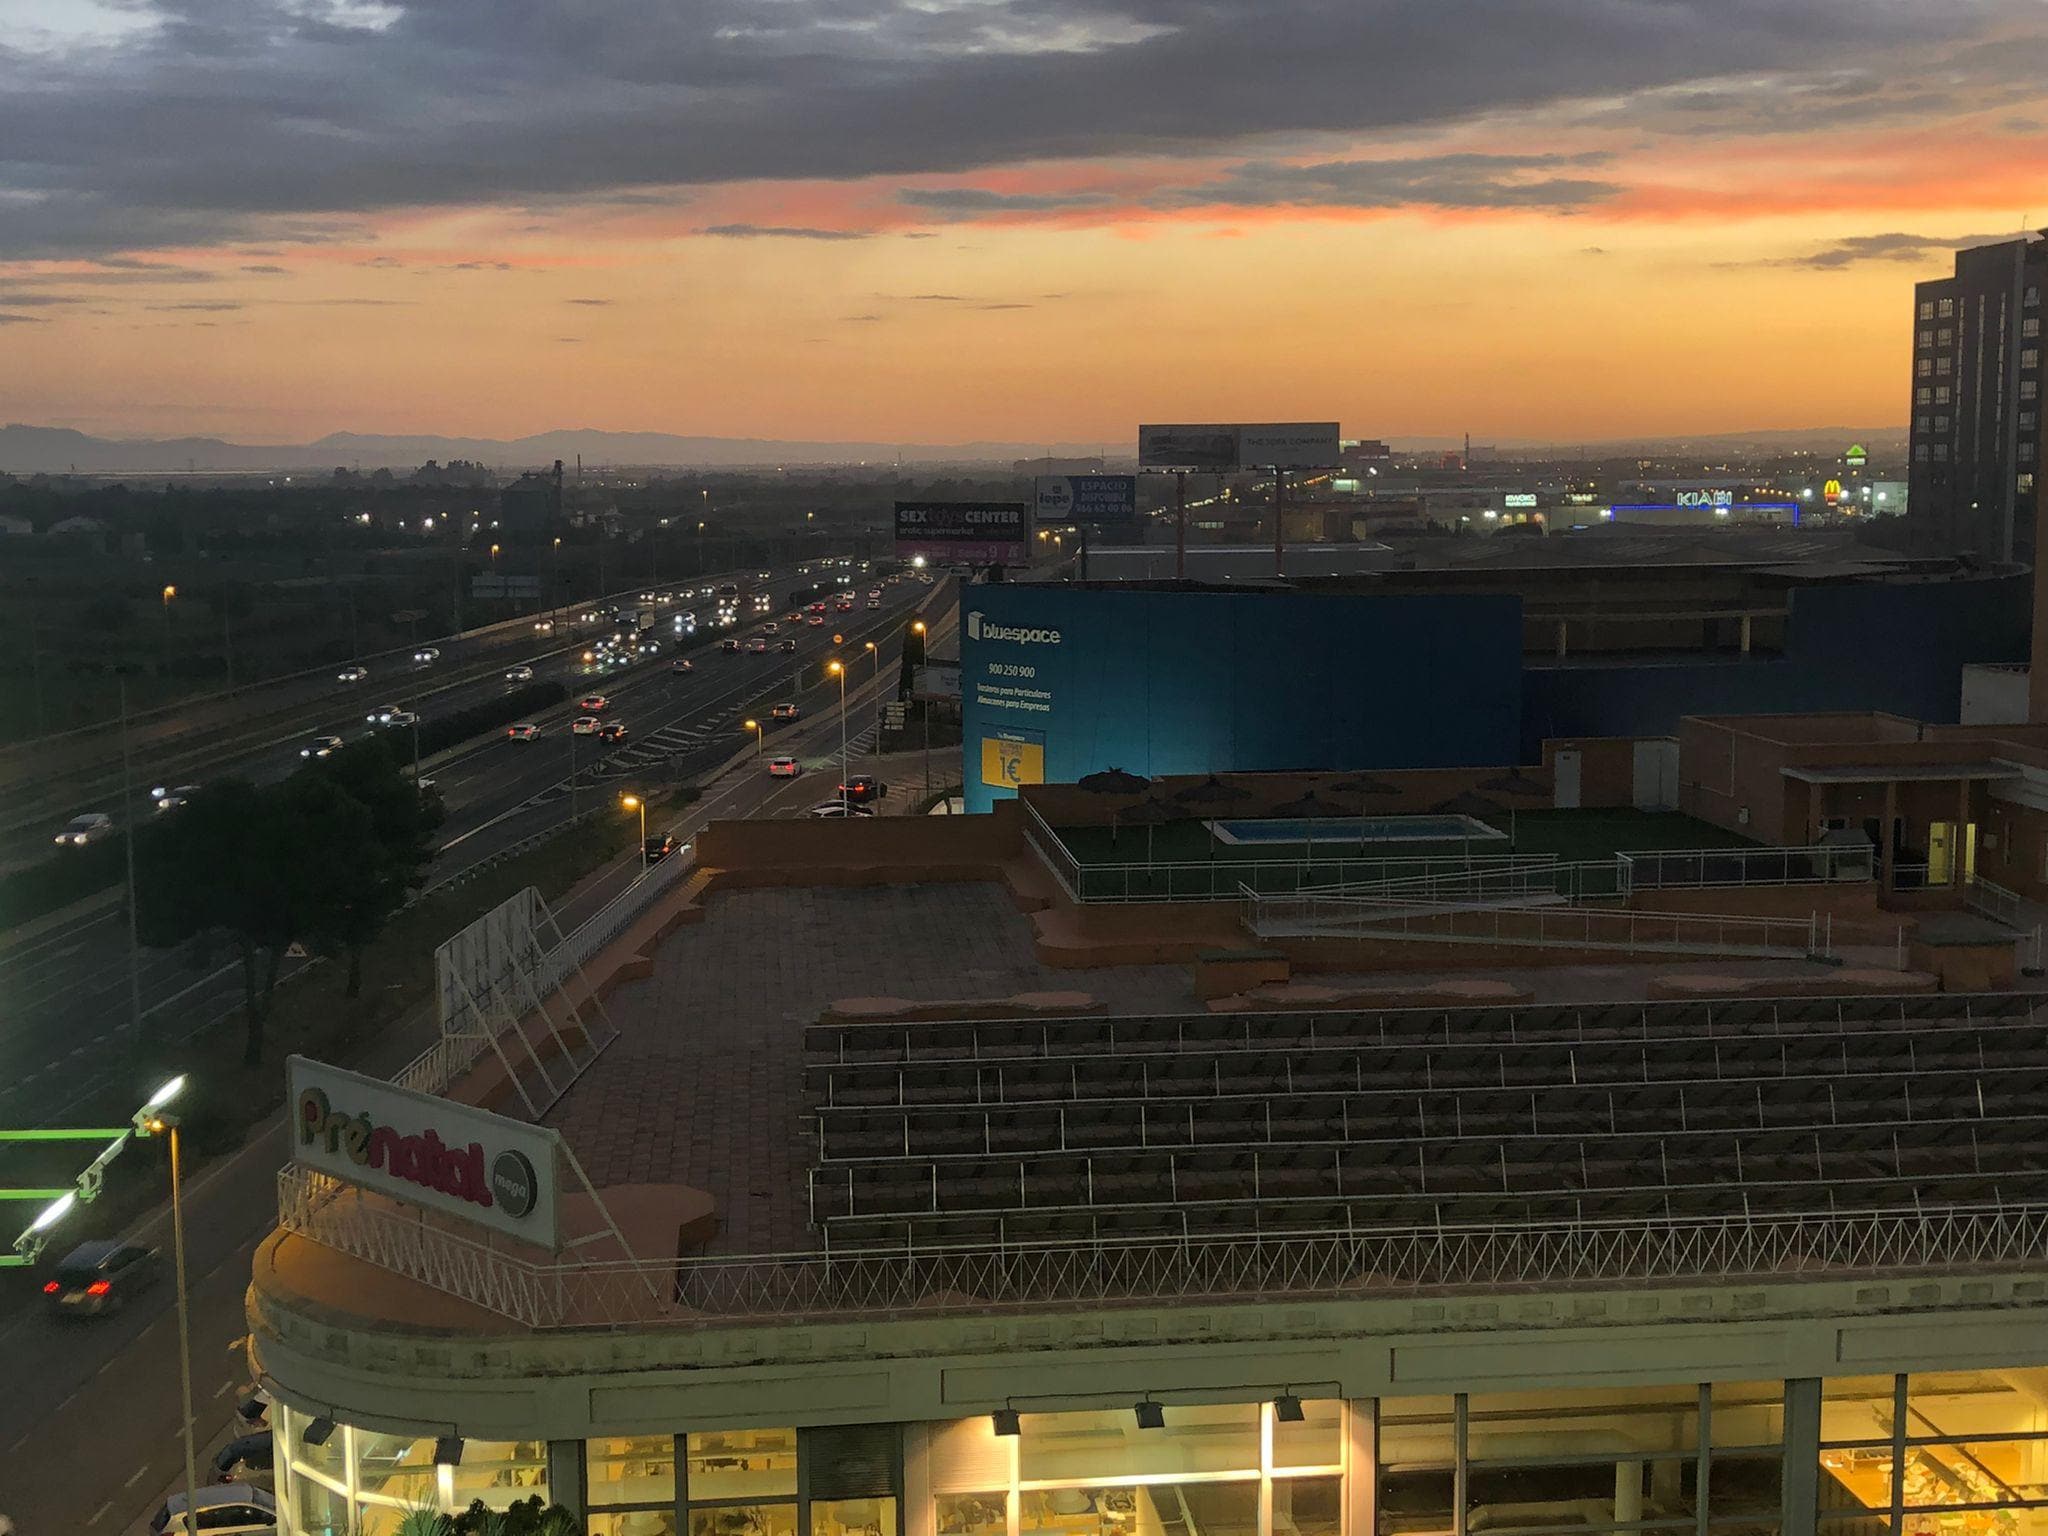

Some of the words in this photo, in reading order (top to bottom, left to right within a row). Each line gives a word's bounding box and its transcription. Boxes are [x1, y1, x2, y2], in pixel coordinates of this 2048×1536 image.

[1080, 481, 1127, 490] ESPACIO
[1677, 491, 1732, 506] KIABI
[899, 510, 927, 523] SEX
[965, 510, 1019, 523] CENTER
[982, 622, 1061, 645] bluespace
[988, 662, 1003, 674] 900
[1003, 664, 1018, 676] 250
[1019, 665, 1035, 678] 900
[1014, 687, 1051, 699] Particulares
[1019, 700, 1050, 712] Empresas
[299, 1086, 493, 1207] Prénatal
[494, 1172, 527, 1197] mega
